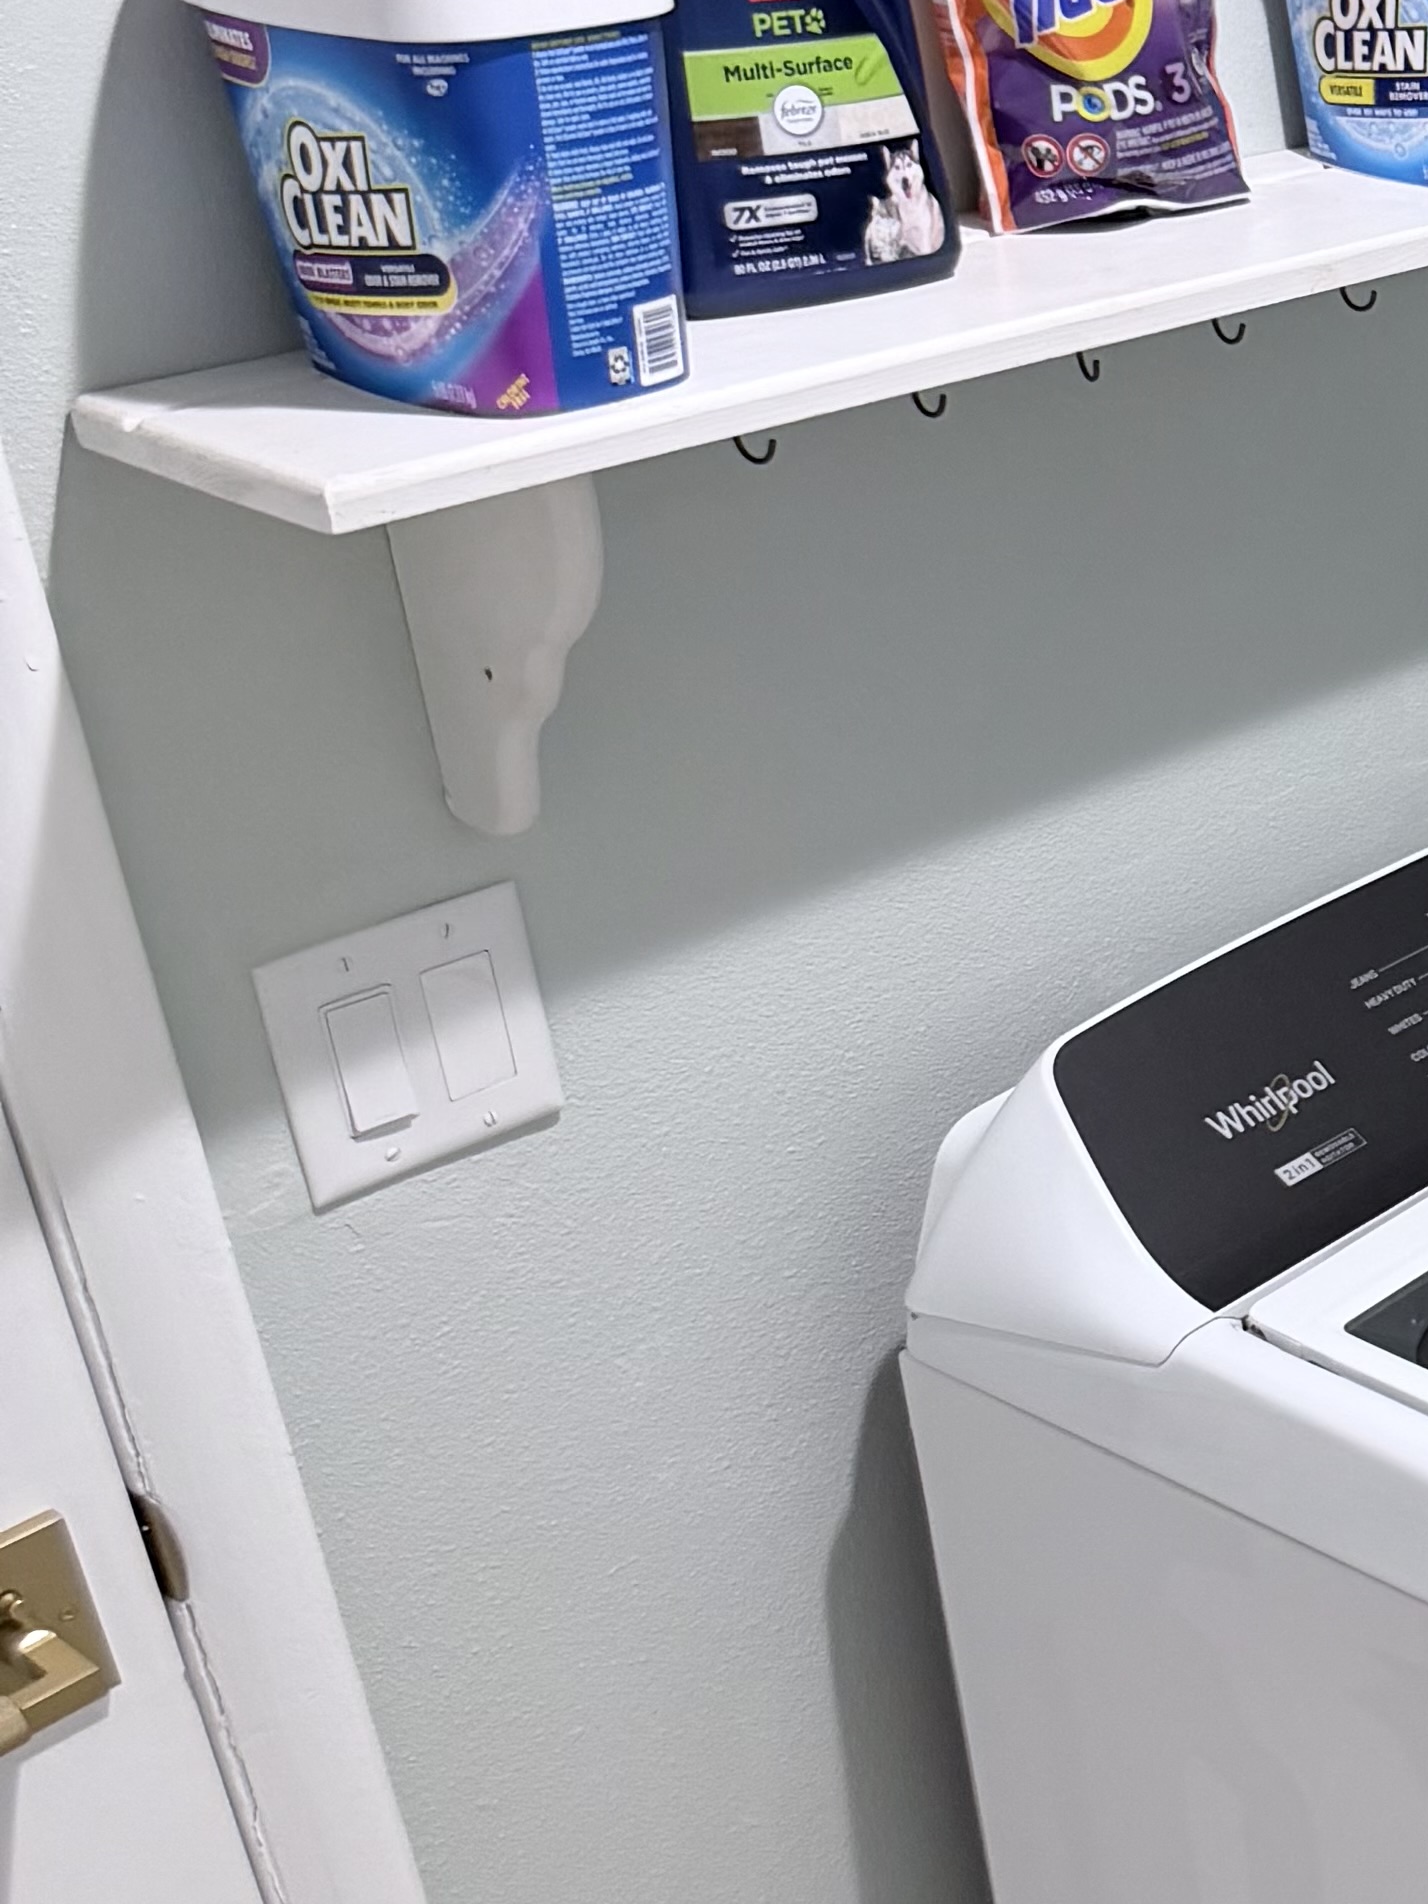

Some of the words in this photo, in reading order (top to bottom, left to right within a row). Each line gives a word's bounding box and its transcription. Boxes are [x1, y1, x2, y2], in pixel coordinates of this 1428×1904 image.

[1314, 18, 1428, 73] CLEAN
[723, 55, 854, 84] Multi-Surface
[1164, 61, 1192, 104] 3
[1050, 74, 1156, 123] PODS
[289, 122, 368, 191] OXI
[283, 176, 414, 250] CLEAN
[731, 204, 763, 226] 7X
[1350, 969, 1379, 990] JEANS
[1364, 988, 1395, 1009] HEAVY
[1392, 977, 1417, 995] DUTY
[1204, 1059, 1336, 1140] Whirlpool
